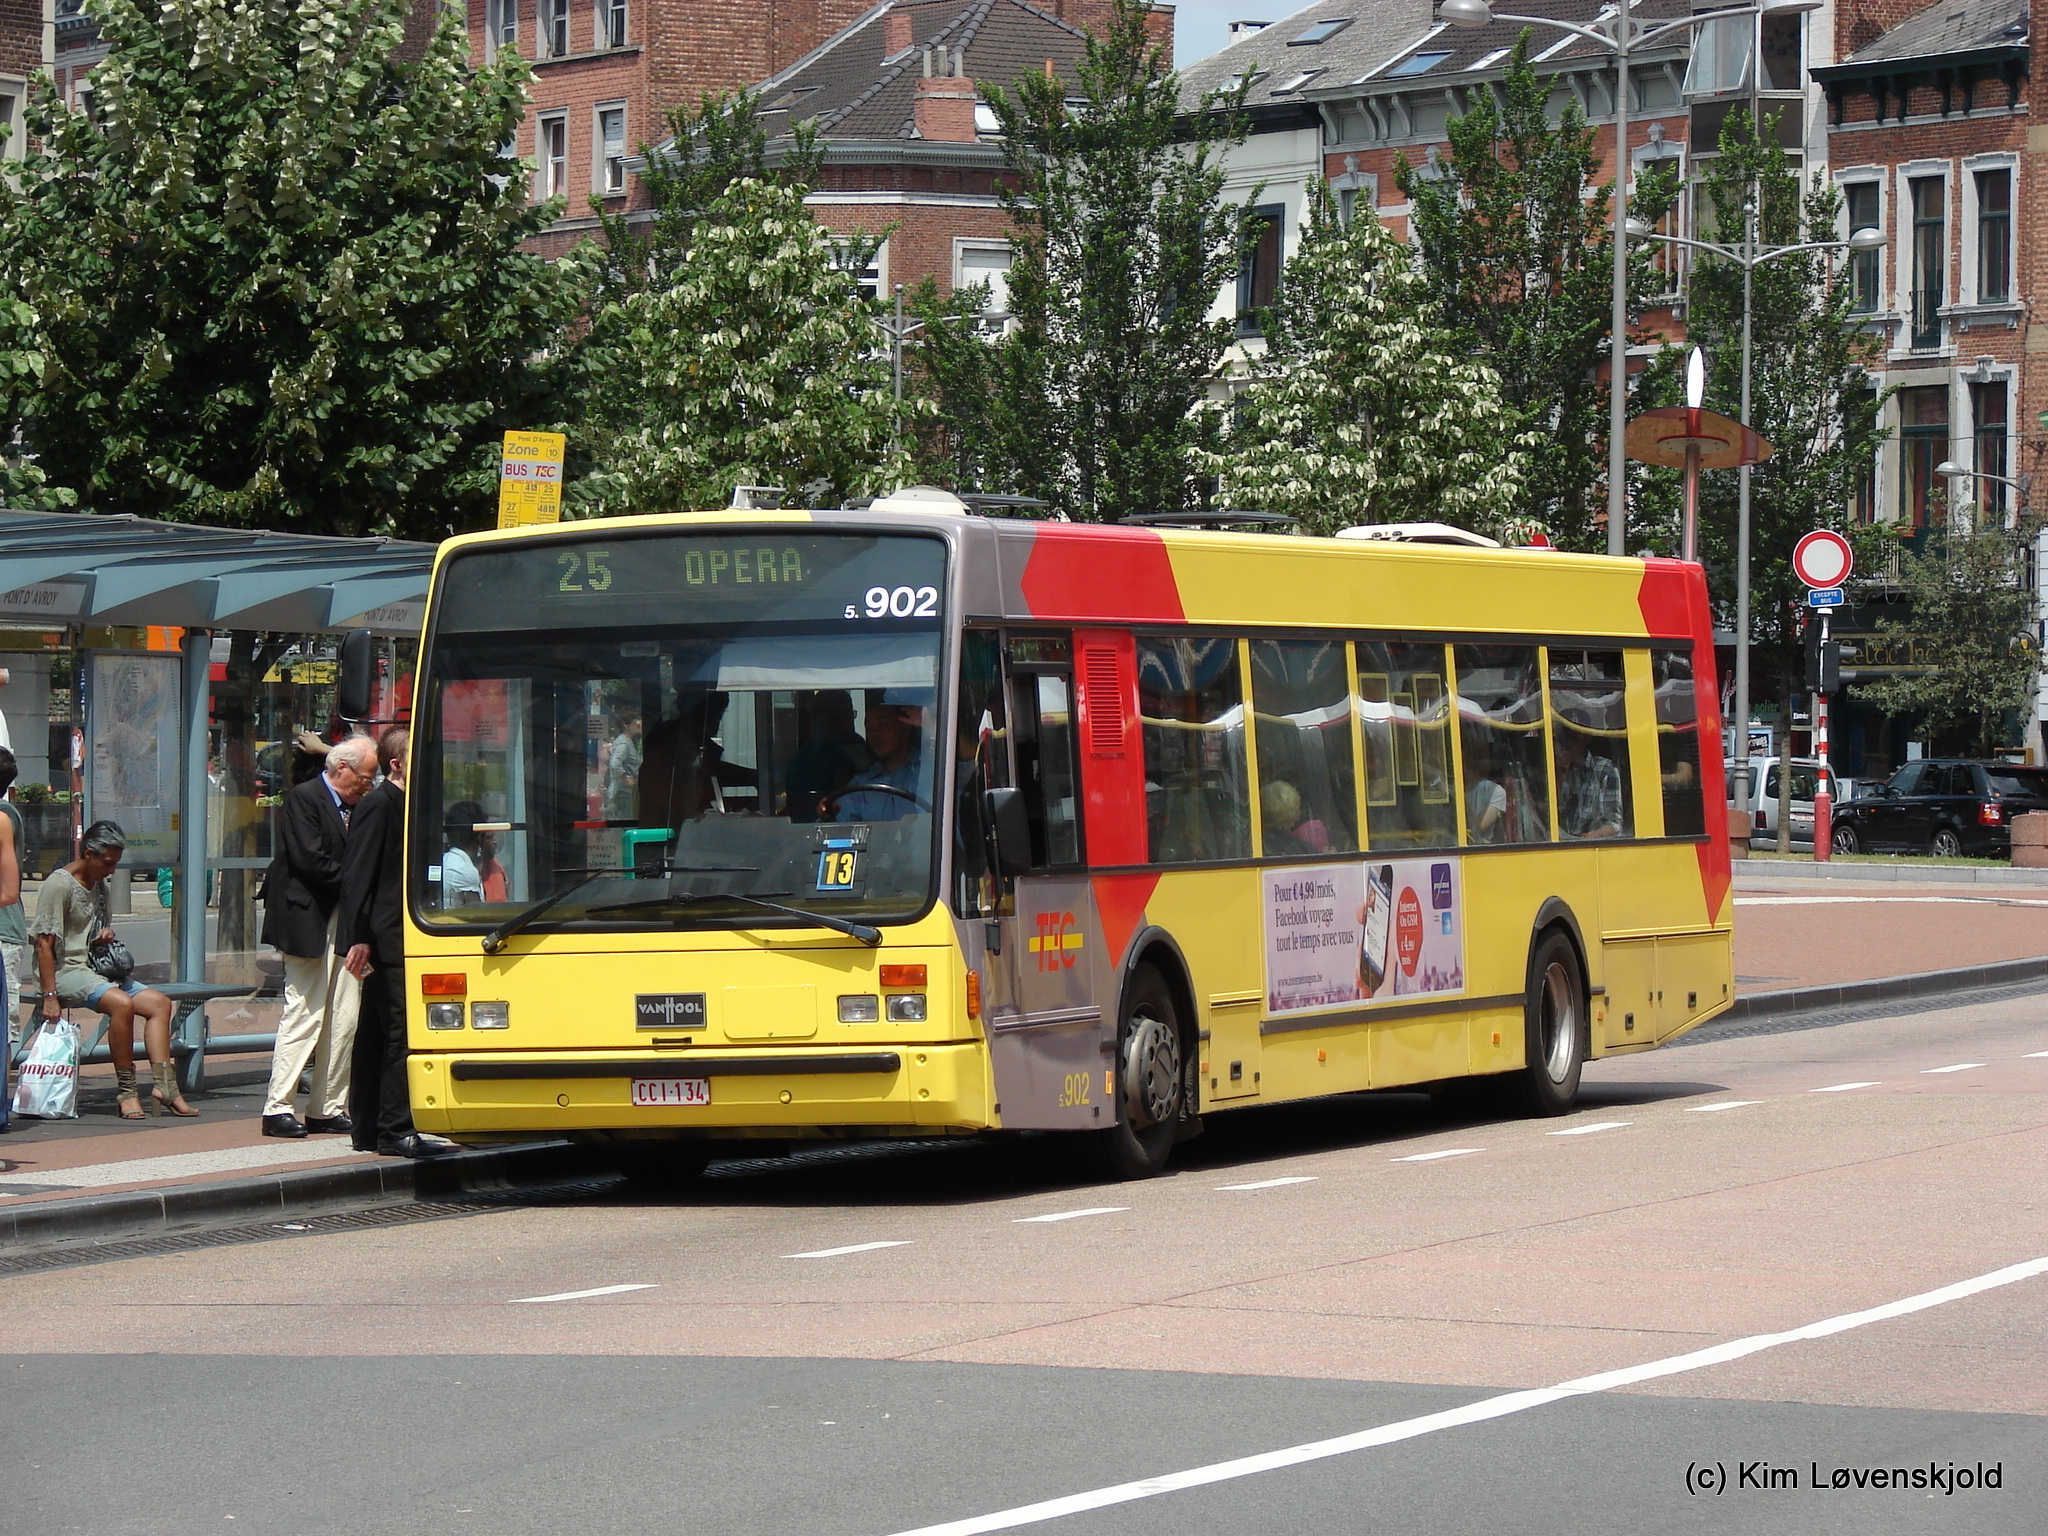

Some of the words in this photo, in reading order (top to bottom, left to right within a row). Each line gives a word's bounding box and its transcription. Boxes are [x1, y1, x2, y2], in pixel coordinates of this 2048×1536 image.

[507, 443, 539, 456] Zone
[549, 449, 558, 457] 10
[505, 463, 528, 476] BUS
[535, 465, 556, 478] TEC
[544, 485, 554, 494] 25
[506, 503, 516, 511] 27
[557, 551, 612, 592] 25
[684, 547, 802, 584] OPERA
[864, 585, 938, 619] 902
[825, 852, 854, 885] 13
[1274, 884, 1292, 902] Pour
[1293, 883, 1298, 900] €
[1275, 905, 1308, 927] Facebook
[1309, 908, 1334, 928] voyage
[1036, 911, 1077, 972] TEC
[1276, 935, 1291, 952] tout
[1291, 931, 1299, 950] le
[1299, 932, 1320, 953] temps
[1321, 931, 1338, 947] avec
[1338, 930, 1354, 944] vous
